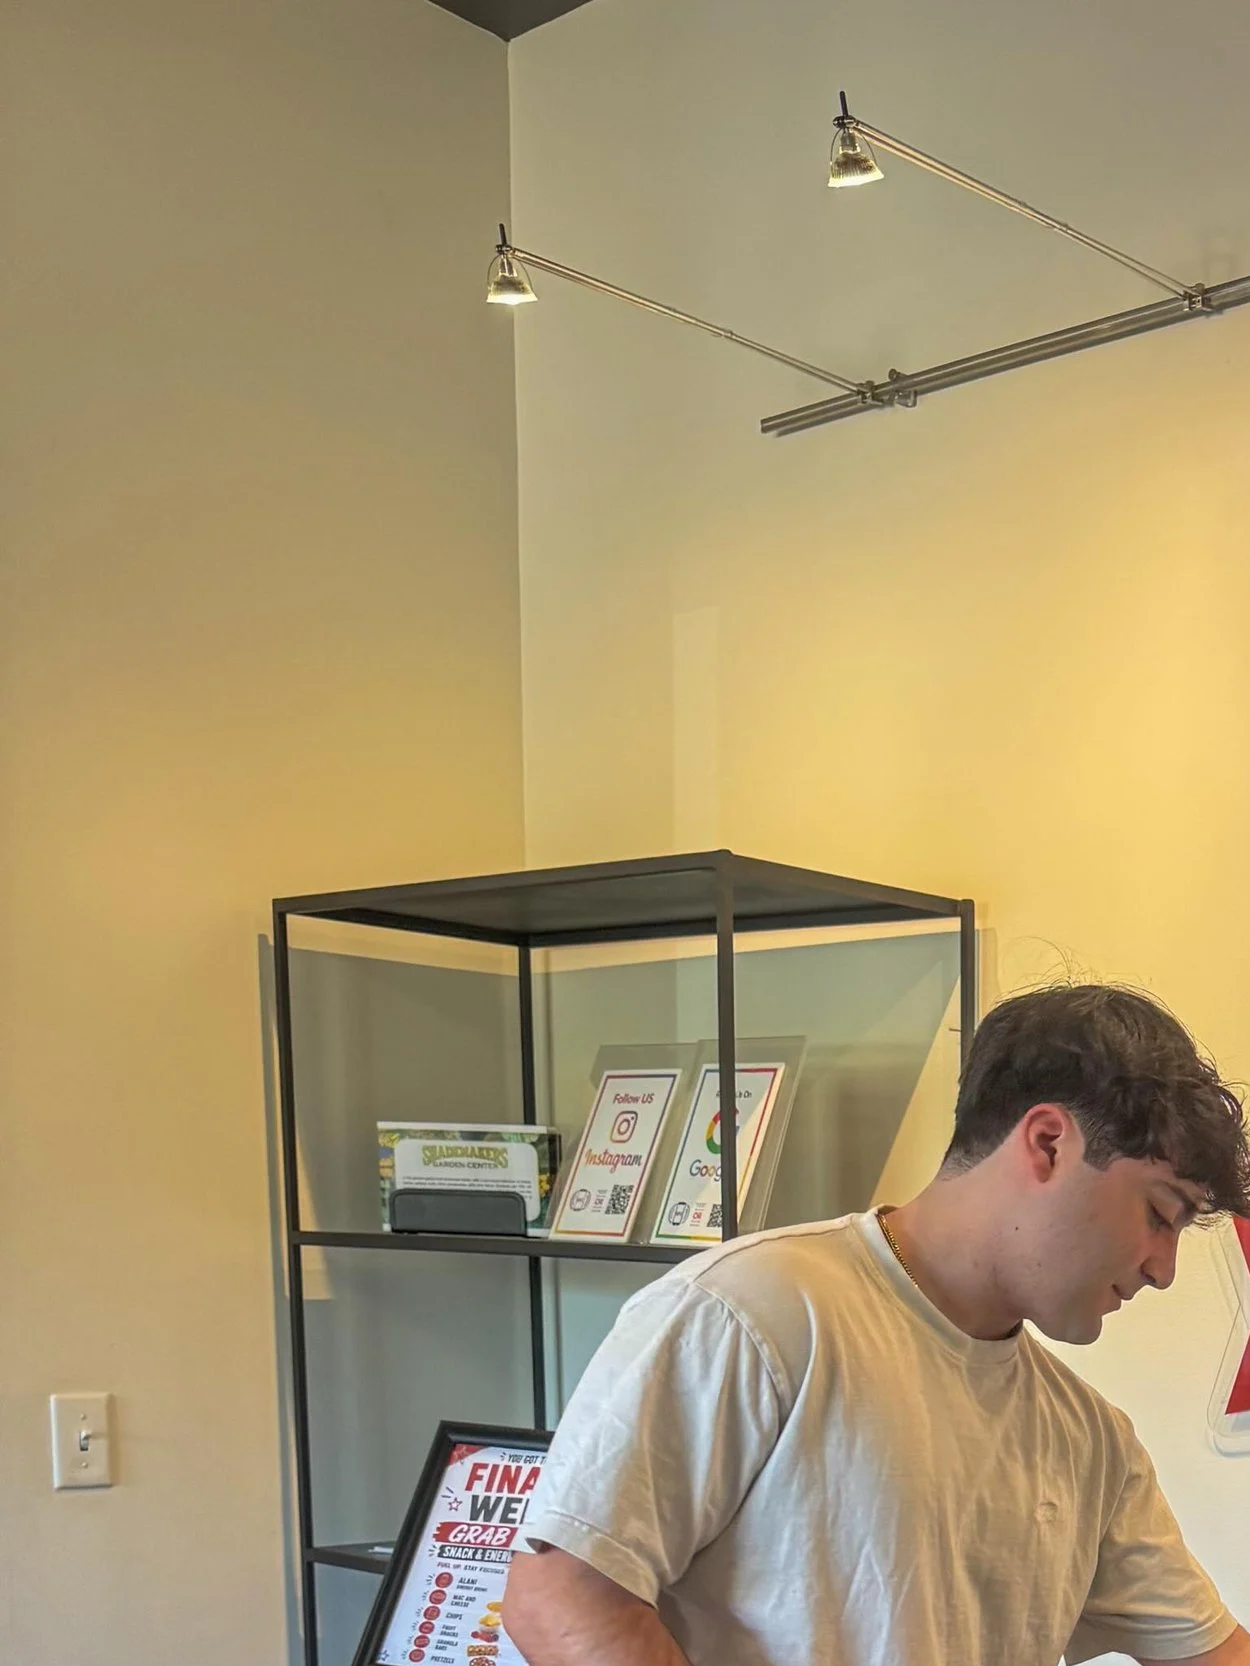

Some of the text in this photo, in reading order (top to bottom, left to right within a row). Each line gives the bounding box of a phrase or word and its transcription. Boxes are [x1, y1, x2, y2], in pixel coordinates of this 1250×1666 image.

[612, 1093, 655, 1104] Follow US
[585, 1148, 643, 1174] Instagram
[689, 1159, 722, 1182] Goog
[465, 1462, 542, 1495] FINA
[469, 1494, 530, 1525] WE
[448, 1525, 511, 1546] GRAB
[443, 1546, 512, 1563] SNACK & ENER
